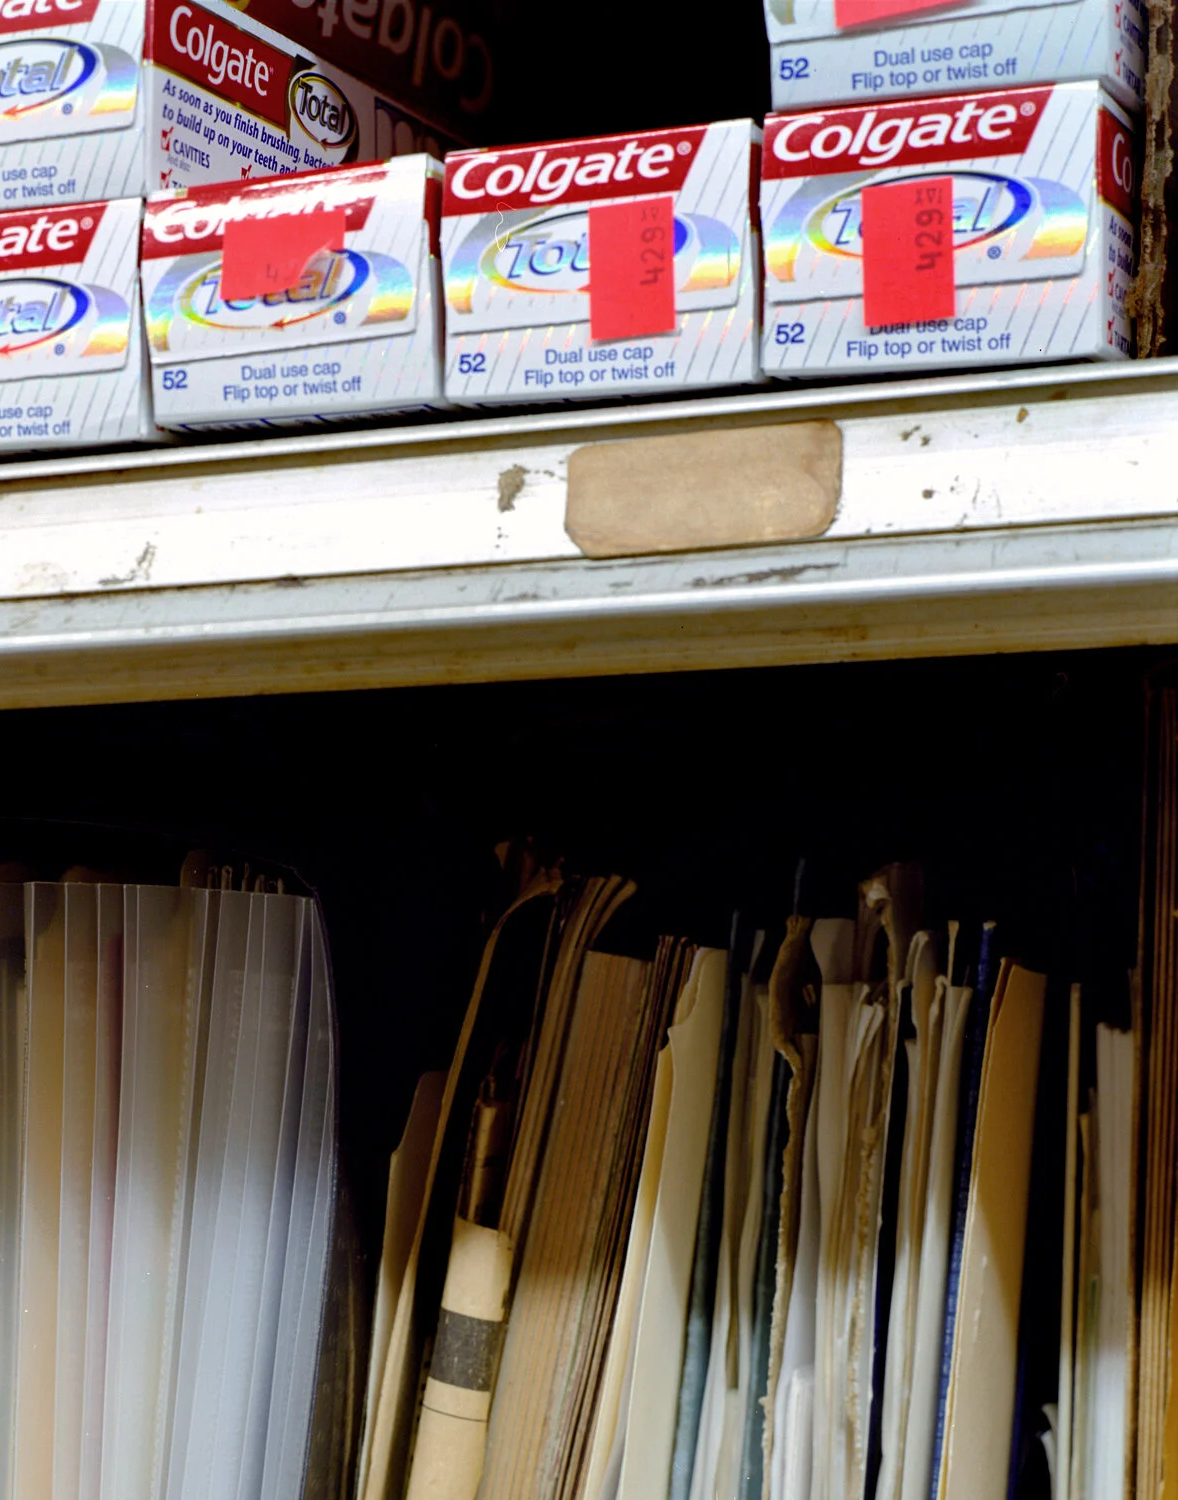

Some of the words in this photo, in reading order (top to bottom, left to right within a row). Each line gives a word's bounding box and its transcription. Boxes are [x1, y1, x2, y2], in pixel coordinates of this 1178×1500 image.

[170, 5, 269, 97] Colgate
[874, 48, 915, 67] Dual
[921, 46, 954, 62] use
[958, 42, 993, 60] cap
[779, 57, 810, 80] 52
[851, 72, 884, 91] Flip
[889, 70, 918, 87] top
[922, 69, 941, 83] or
[947, 64, 988, 81] twist
[993, 58, 1018, 76] off
[162, 78, 176, 97] As
[178, 88, 202, 111] soon
[202, 99, 214, 117] as
[214, 108, 233, 127] you
[234, 113, 259, 141] finish
[260, 129, 302, 164] brushing,
[298, 80, 348, 137] Total
[162, 104, 175, 121] to
[176, 109, 202, 135] build
[203, 126, 216, 144] up
[217, 133, 230, 149] on
[231, 140, 253, 159] your
[253, 152, 279, 174] teeth
[773, 102, 1018, 165] Colgate
[172, 138, 211, 169] CAVITIES
[451, 141, 675, 203] Colgate
[774, 322, 806, 345] 52
[458, 352, 487, 375] 52
[544, 348, 584, 366] Dual
[588, 347, 618, 362] use
[622, 345, 654, 364] cap
[524, 369, 554, 388] Flip
[558, 369, 586, 387] top
[589, 369, 606, 382] or
[610, 363, 649, 381] twist
[653, 362, 676, 379] off
[162, 370, 189, 391] 52
[27, 404, 53, 420] cap
[4, 425, 15, 437] or
[16, 421, 49, 436] twist
[53, 420, 71, 435] off
